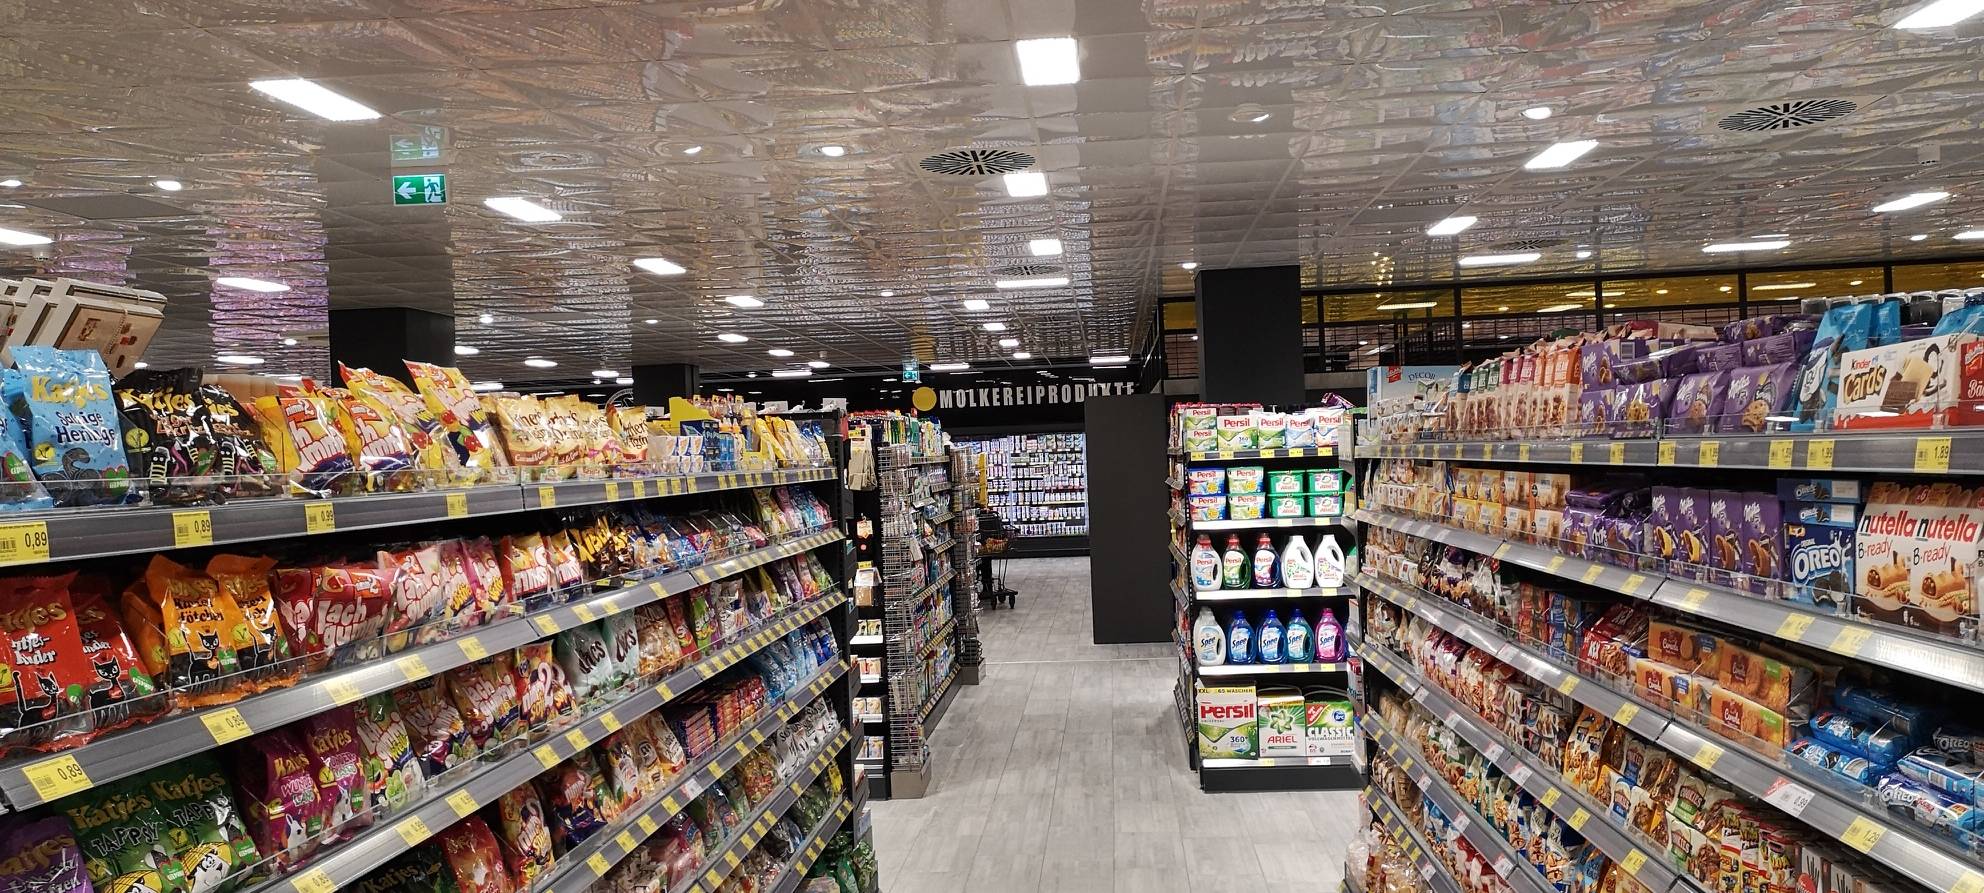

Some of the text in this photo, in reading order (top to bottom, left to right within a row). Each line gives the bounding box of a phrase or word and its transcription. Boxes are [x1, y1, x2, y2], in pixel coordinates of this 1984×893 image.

[939, 381, 1135, 409] MOLKEREIPRODUKTE
[56, 411, 104, 427] Salige
[1223, 418, 1250, 428] Persil
[1260, 418, 1284, 427] Persil
[1318, 415, 1342, 424] Persil
[1860, 510, 1918, 537] nutella
[1916, 513, 1979, 543] nutella
[25, 531, 48, 551] 0,89
[1794, 548, 1841, 580] OREO
[1200, 703, 1254, 719] Persil
[1267, 735, 1298, 744] ARIEL
[1307, 726, 1354, 738] CLASSIC
[57, 763, 84, 782] 0,89
[174, 799, 219, 827] TAPP
